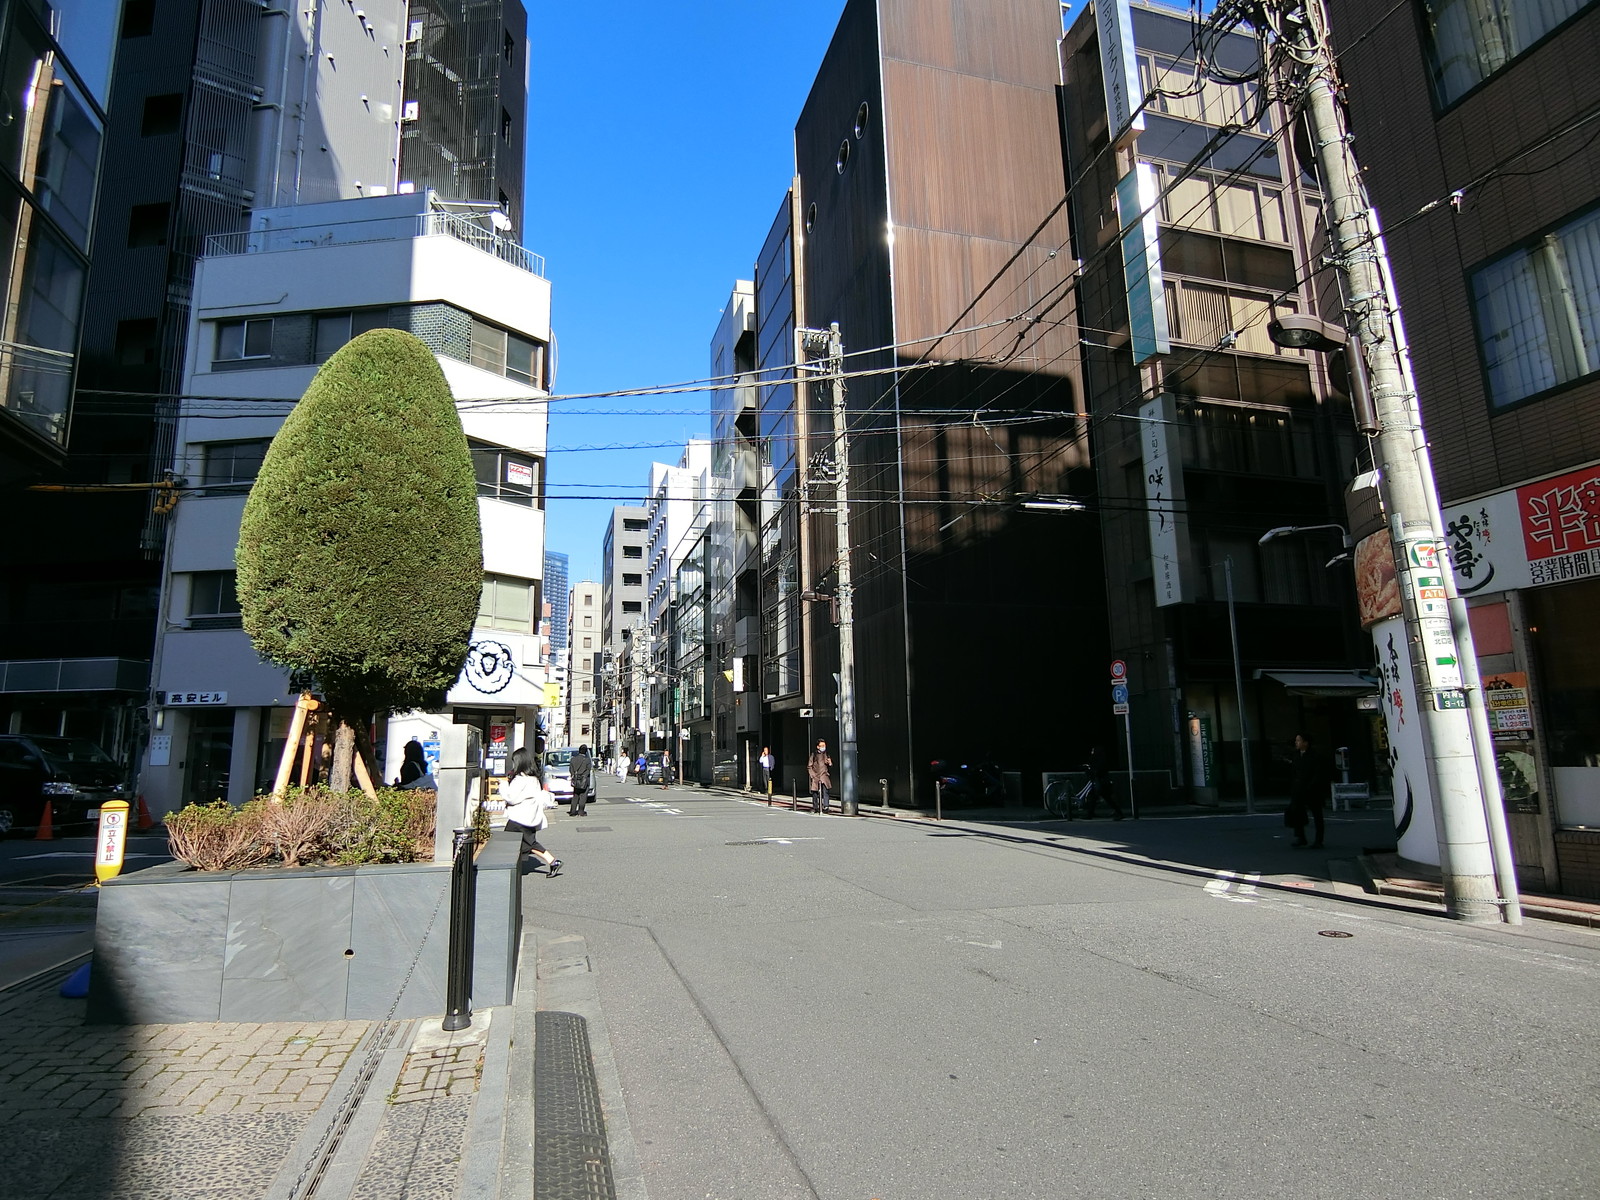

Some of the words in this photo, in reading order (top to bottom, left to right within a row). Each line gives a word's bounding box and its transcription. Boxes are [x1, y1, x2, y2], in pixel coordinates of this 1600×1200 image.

[1530, 551, 1591, 585] 営業時間
[105, 829, 117, 861] 立入禁止
